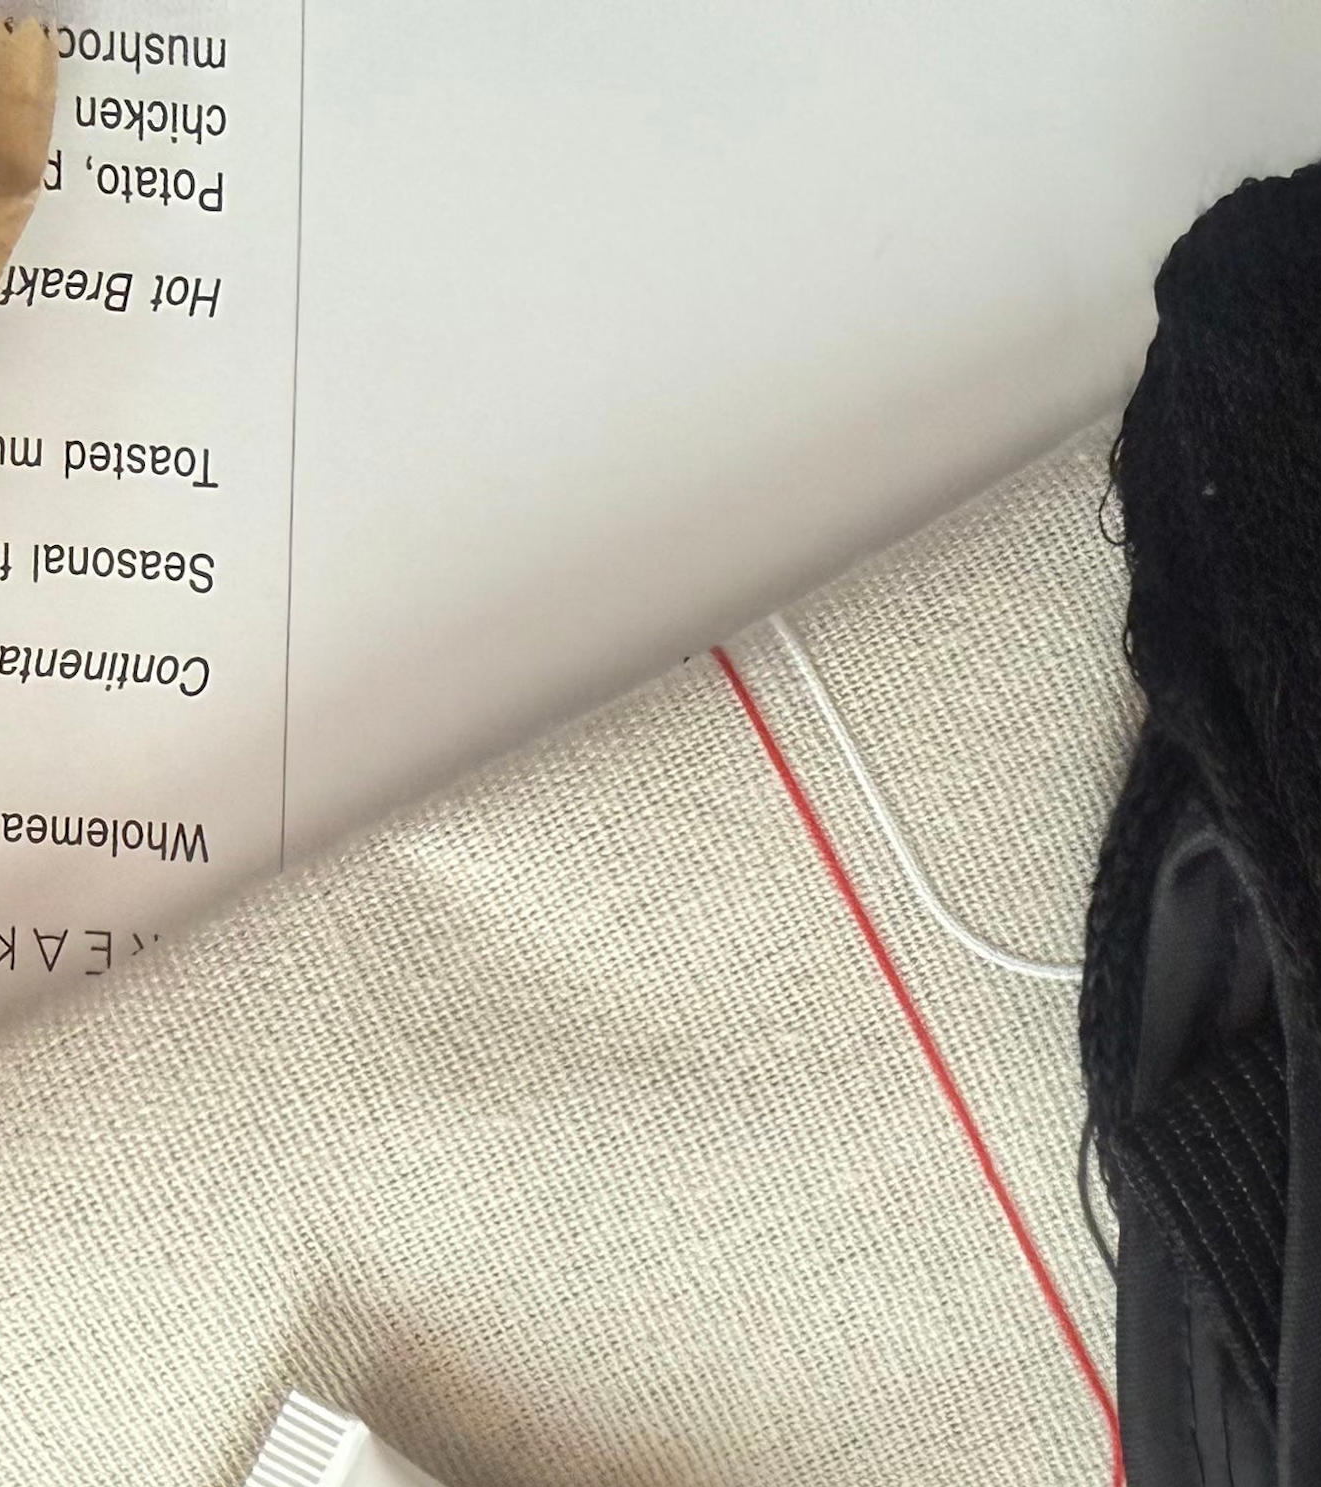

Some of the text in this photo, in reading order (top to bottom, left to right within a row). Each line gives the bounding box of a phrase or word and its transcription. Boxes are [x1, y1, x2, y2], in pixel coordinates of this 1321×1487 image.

[76, 96, 227, 145] chicken
[86, 156, 224, 212] Potato,
[150, 275, 221, 318] Hot
[65, 440, 219, 489] Toasted
[33, 544, 215, 594] Seasonal
